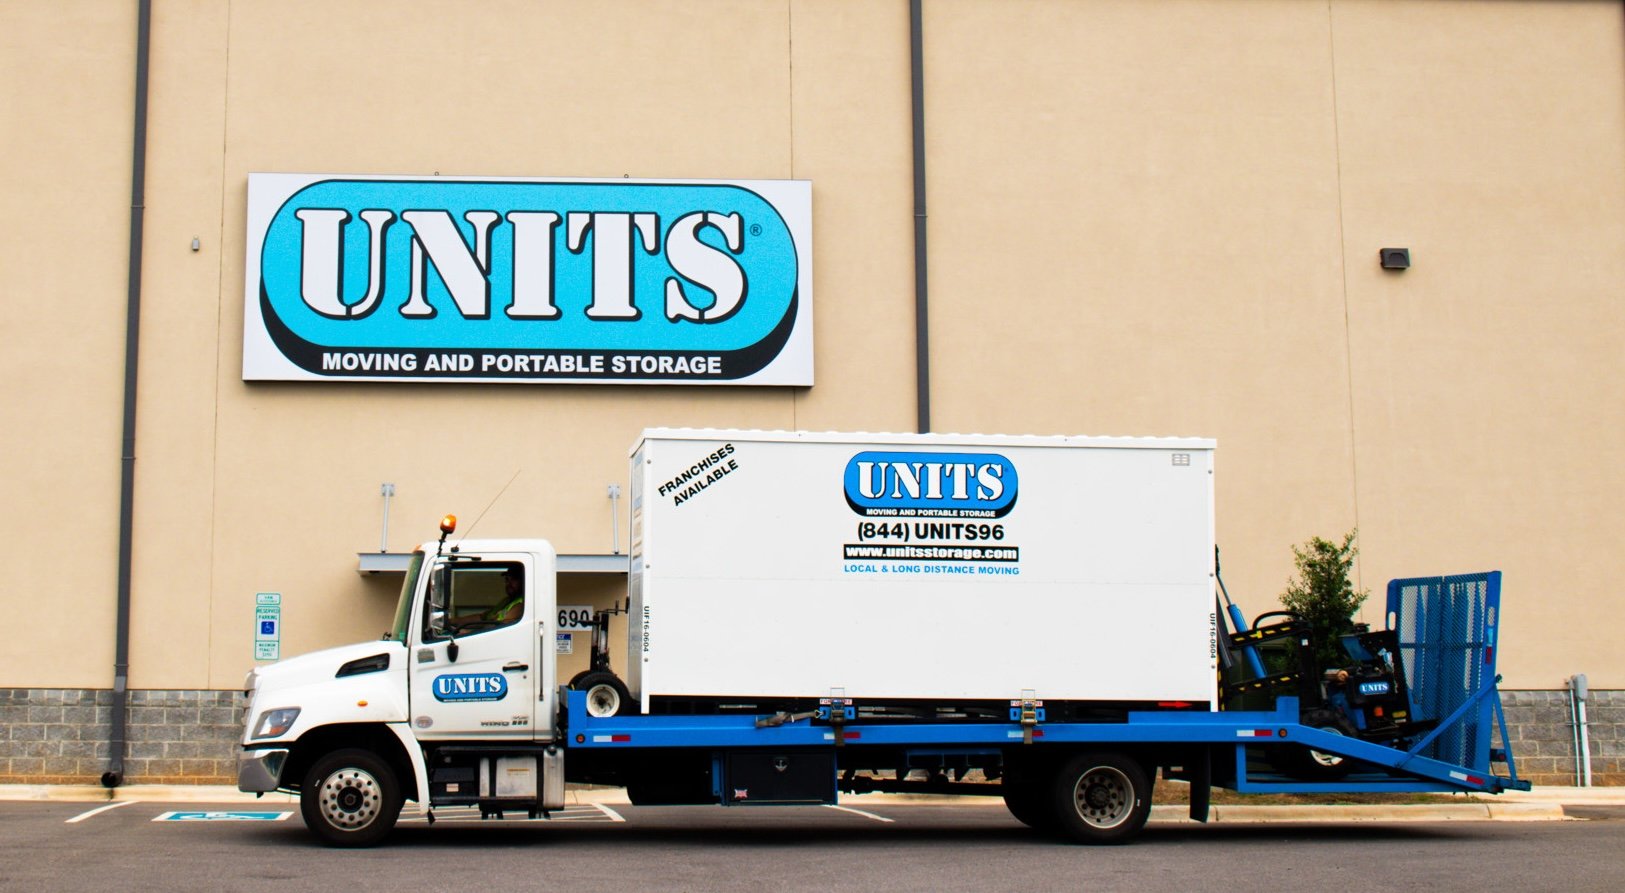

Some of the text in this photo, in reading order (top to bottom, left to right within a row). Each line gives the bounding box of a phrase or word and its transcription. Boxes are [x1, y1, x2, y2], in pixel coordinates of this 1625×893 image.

[294, 207, 749, 325] UNITS
[321, 352, 722, 375] MOVING AND PORTABLE STORAGE
[657, 443, 735, 497] FRANCHISES
[673, 459, 739, 506] AVAILABLE
[857, 461, 1005, 500] UNITS
[866, 508, 996, 518] MOVING AND PORTABLE STORAGE
[857, 522, 1005, 542] (844) UNITS96
[845, 546, 1017, 560] www.unitsstorage.com
[844, 564, 1020, 575] LOCAL & LONG DISTANCE MOVING
[438, 676, 501, 695] UNITS
[1361, 682, 1388, 693] UNITS
